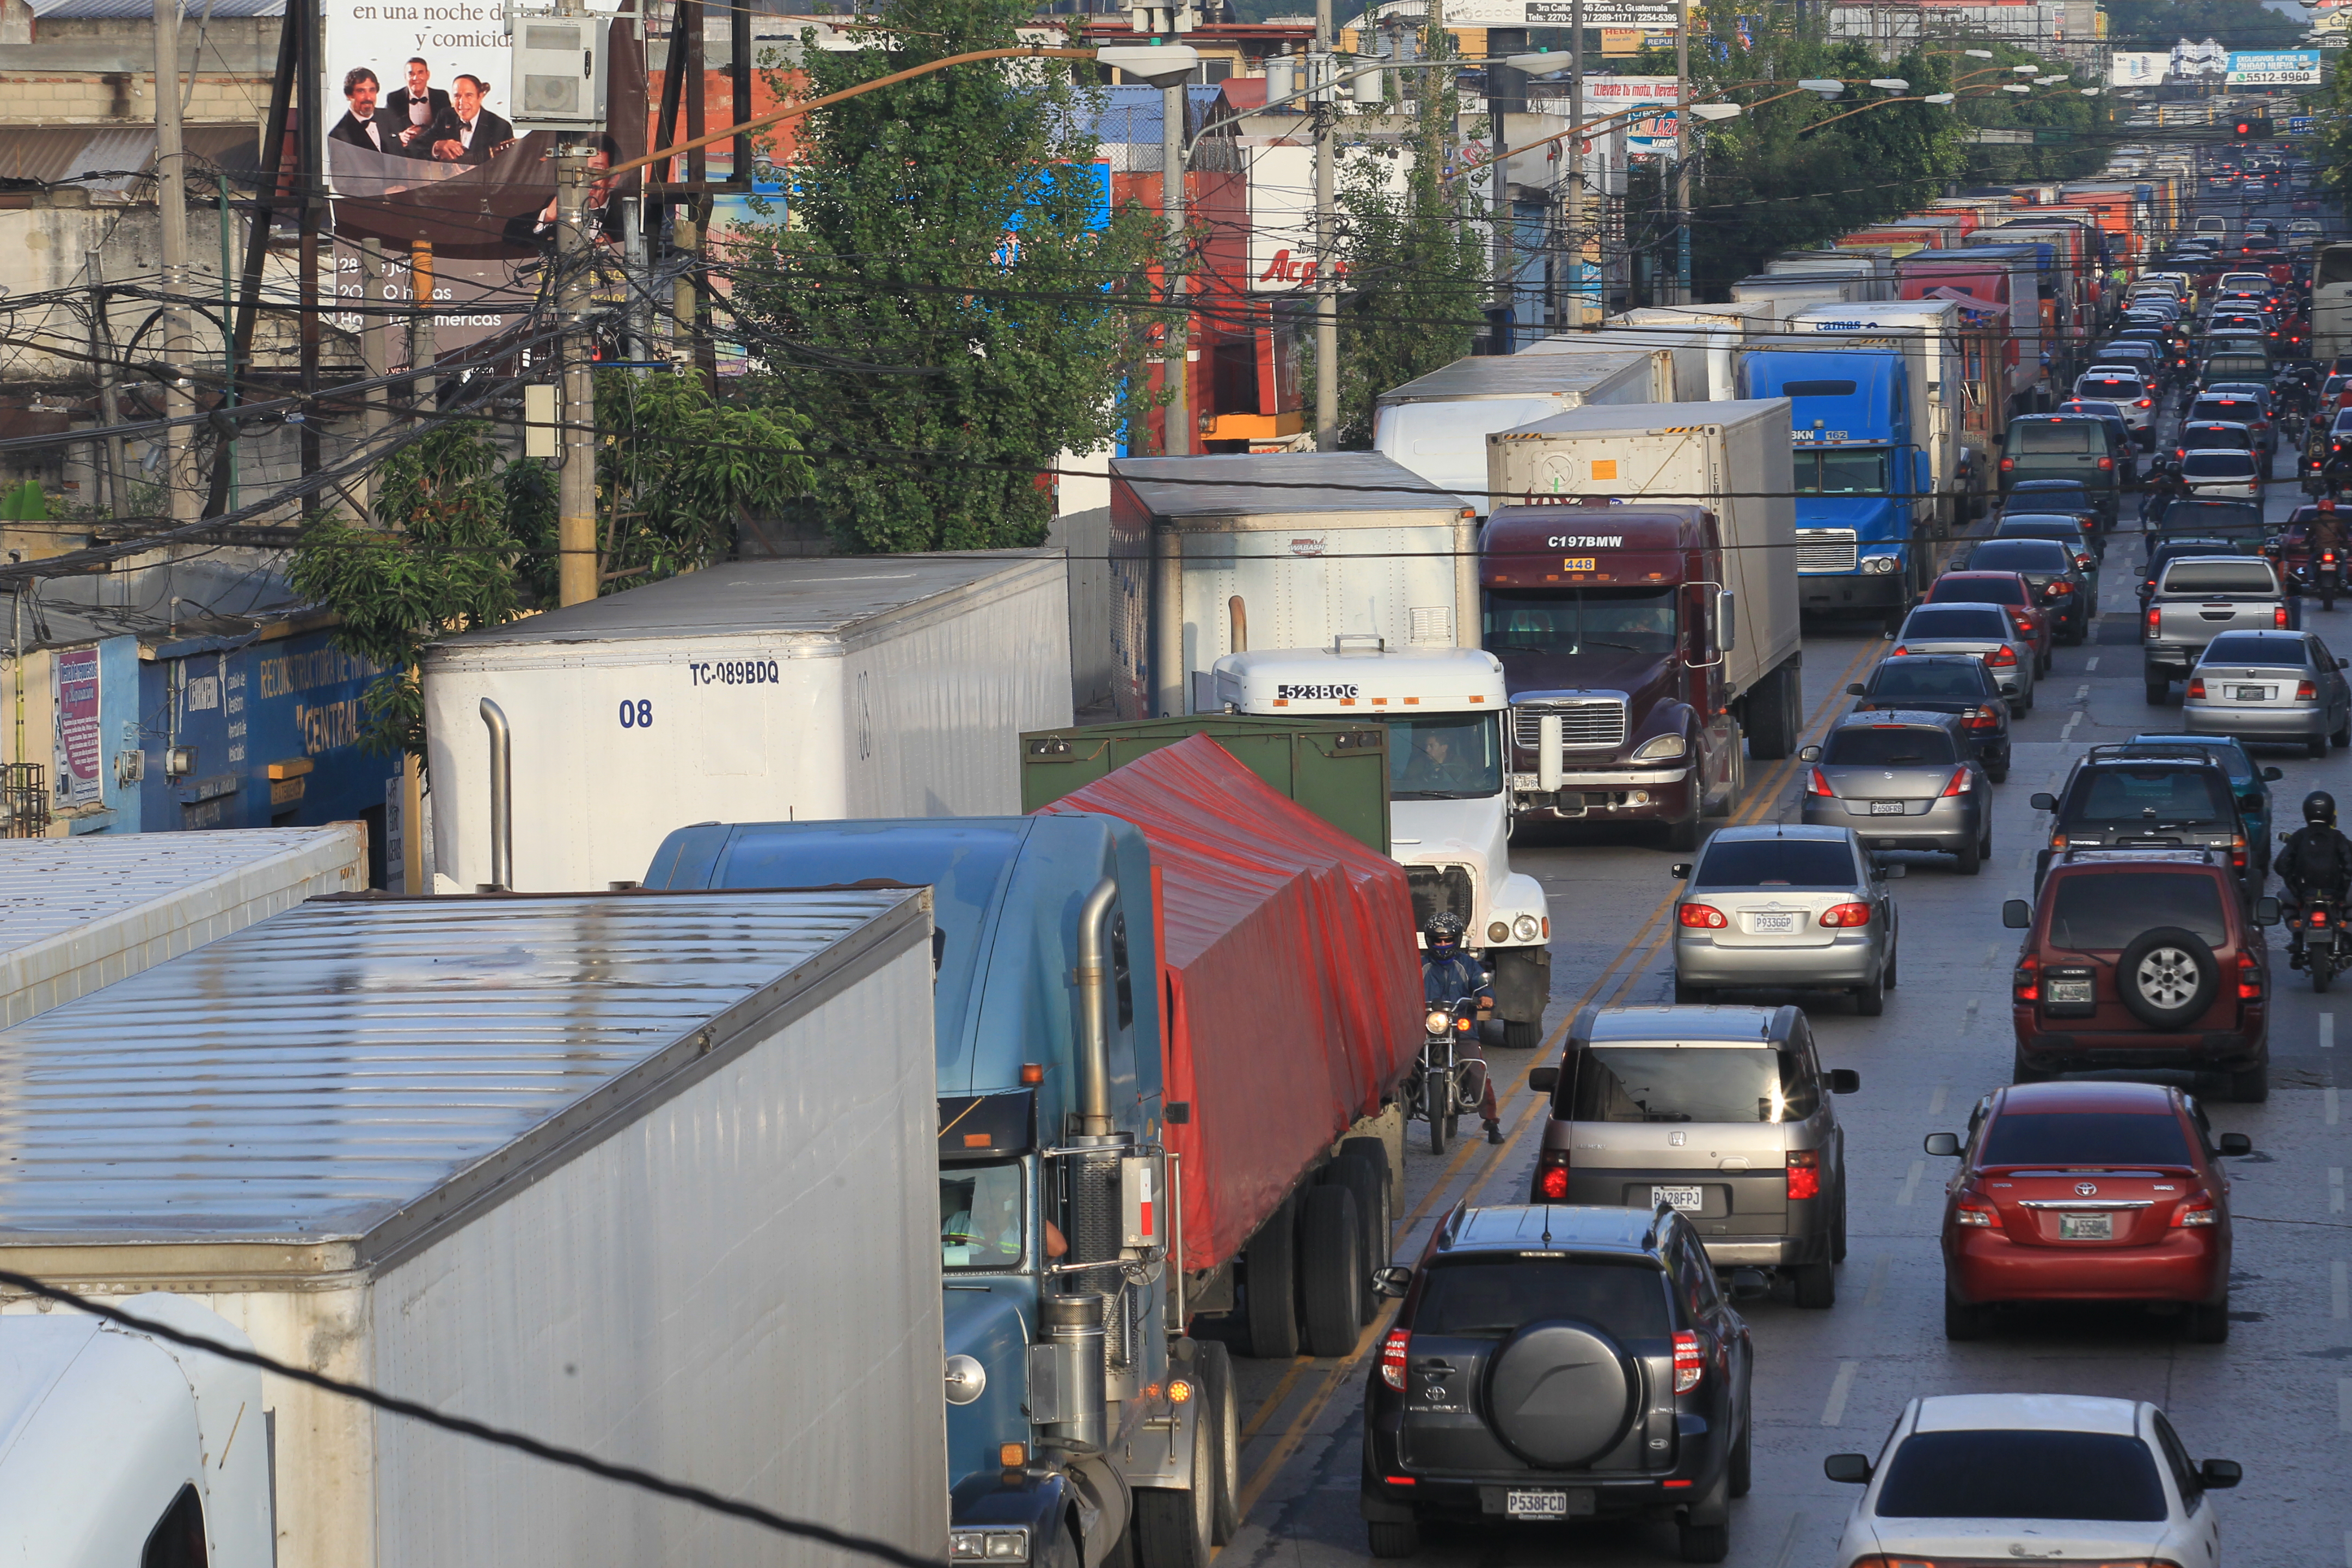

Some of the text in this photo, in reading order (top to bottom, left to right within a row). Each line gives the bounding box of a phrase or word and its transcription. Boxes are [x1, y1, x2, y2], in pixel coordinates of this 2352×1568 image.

[353, 6, 377, 19] en
[383, 6, 419, 19] una
[424, 3, 484, 21] noche
[489, 3, 505, 20] d
[1536, 4, 1549, 12] 3ra
[1551, 4, 1571, 12] Calle
[1615, 4, 1624, 13] 2,
[1625, 4, 1668, 13] Guatemala
[1527, 13, 1546, 21] Tels:
[1638, 13, 1677, 21] 2254-5399
[414, 30, 513, 51] y comicid
[2246, 72, 2310, 82] 5512-9960
[339, 258, 358, 273] 28
[403, 284, 452, 300] has
[434, 314, 502, 327] mericas
[1827, 431, 1847, 440] 162
[1289, 544, 1326, 552] WABASH
[1548, 536, 1622, 548] C197BMW
[1565, 560, 1593, 570] 448
[689, 660, 779, 686] TC-089BDQ
[619, 700, 653, 728] 08
[1756, 917, 1791, 927] P933GGP
[1510, 1496, 1565, 1511] P538FCD
